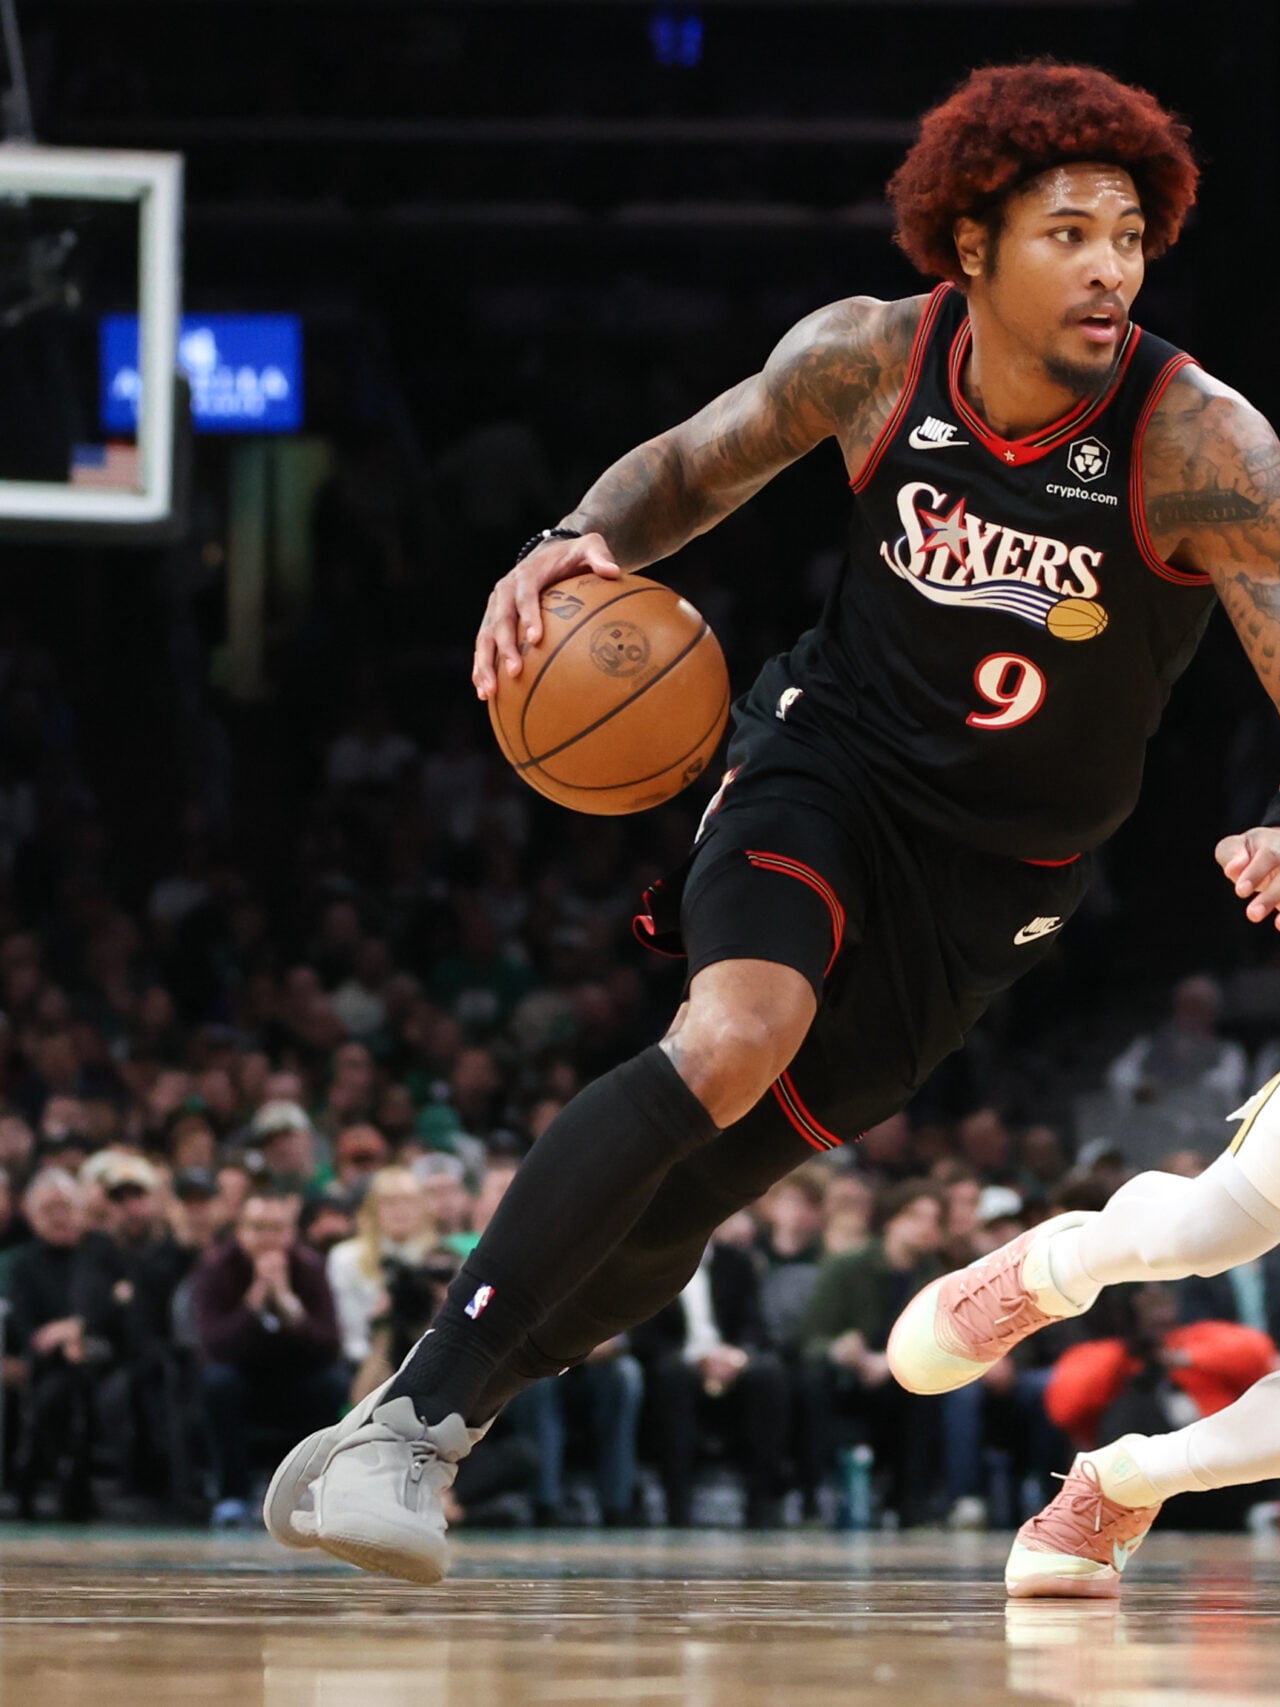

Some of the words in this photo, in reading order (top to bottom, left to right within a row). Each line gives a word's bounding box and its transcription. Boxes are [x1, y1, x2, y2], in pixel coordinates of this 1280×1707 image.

[918, 415, 958, 442] NIKE
[1046, 482, 1119, 507] crypto.com
[966, 652, 1047, 730] 9
